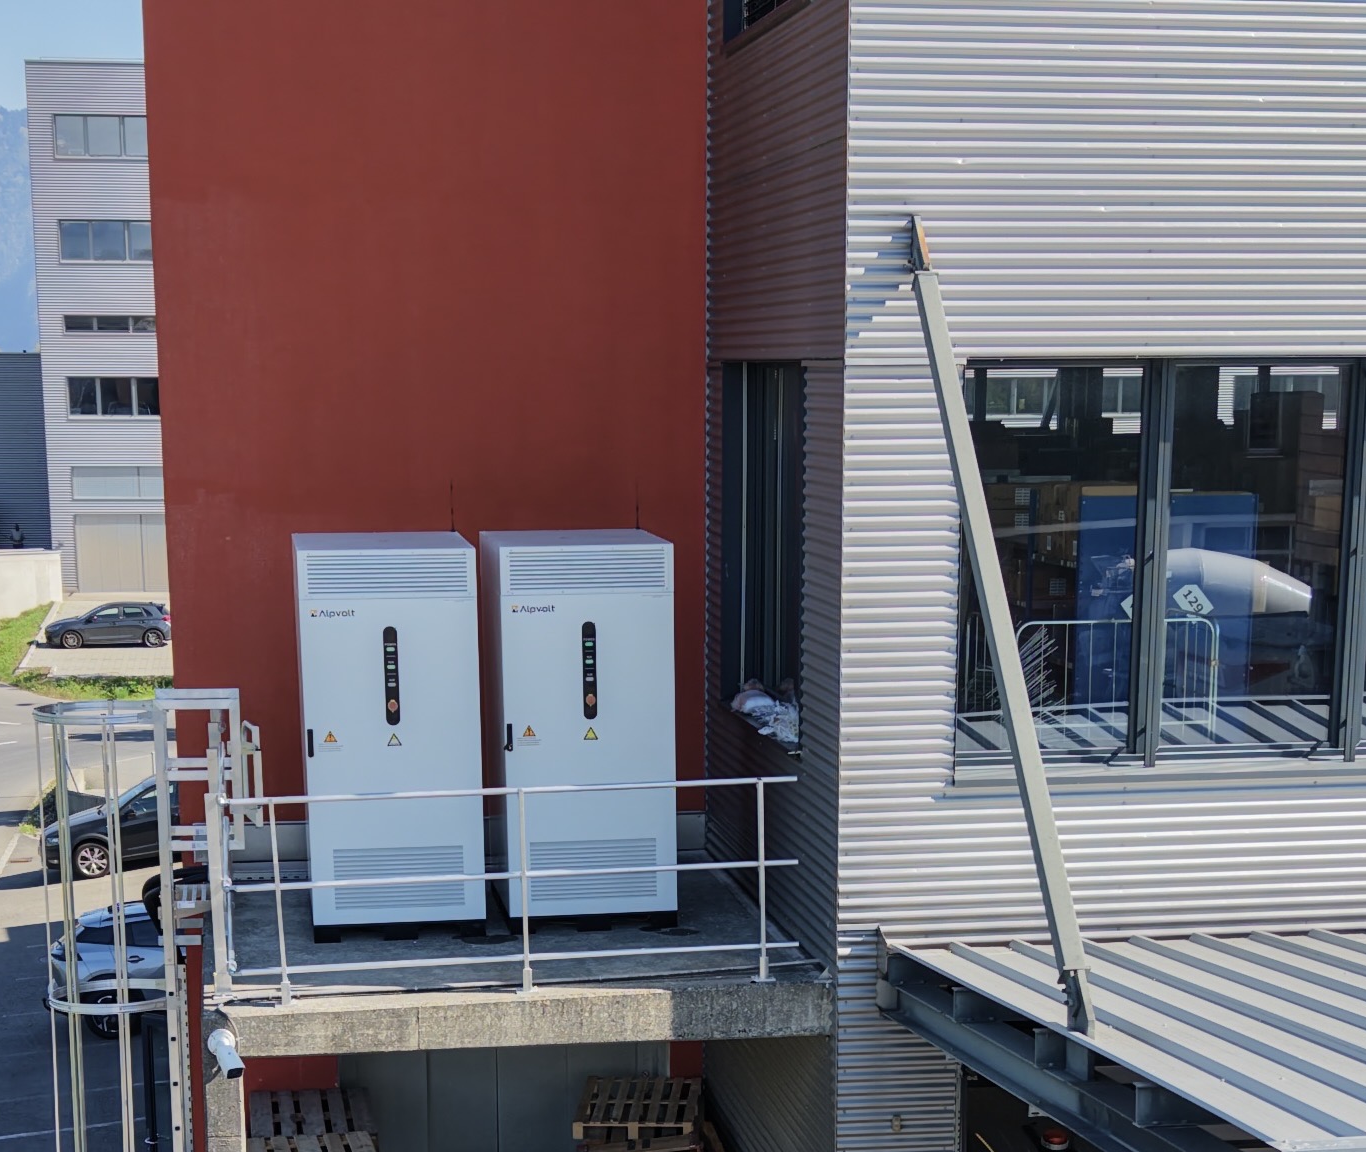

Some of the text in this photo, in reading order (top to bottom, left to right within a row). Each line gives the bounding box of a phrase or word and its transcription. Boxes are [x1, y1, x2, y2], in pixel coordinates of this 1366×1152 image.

[1182, 589, 1204, 613] 129
[319, 609, 356, 619] Alpvolt
[519, 604, 556, 614] Alpvolt
